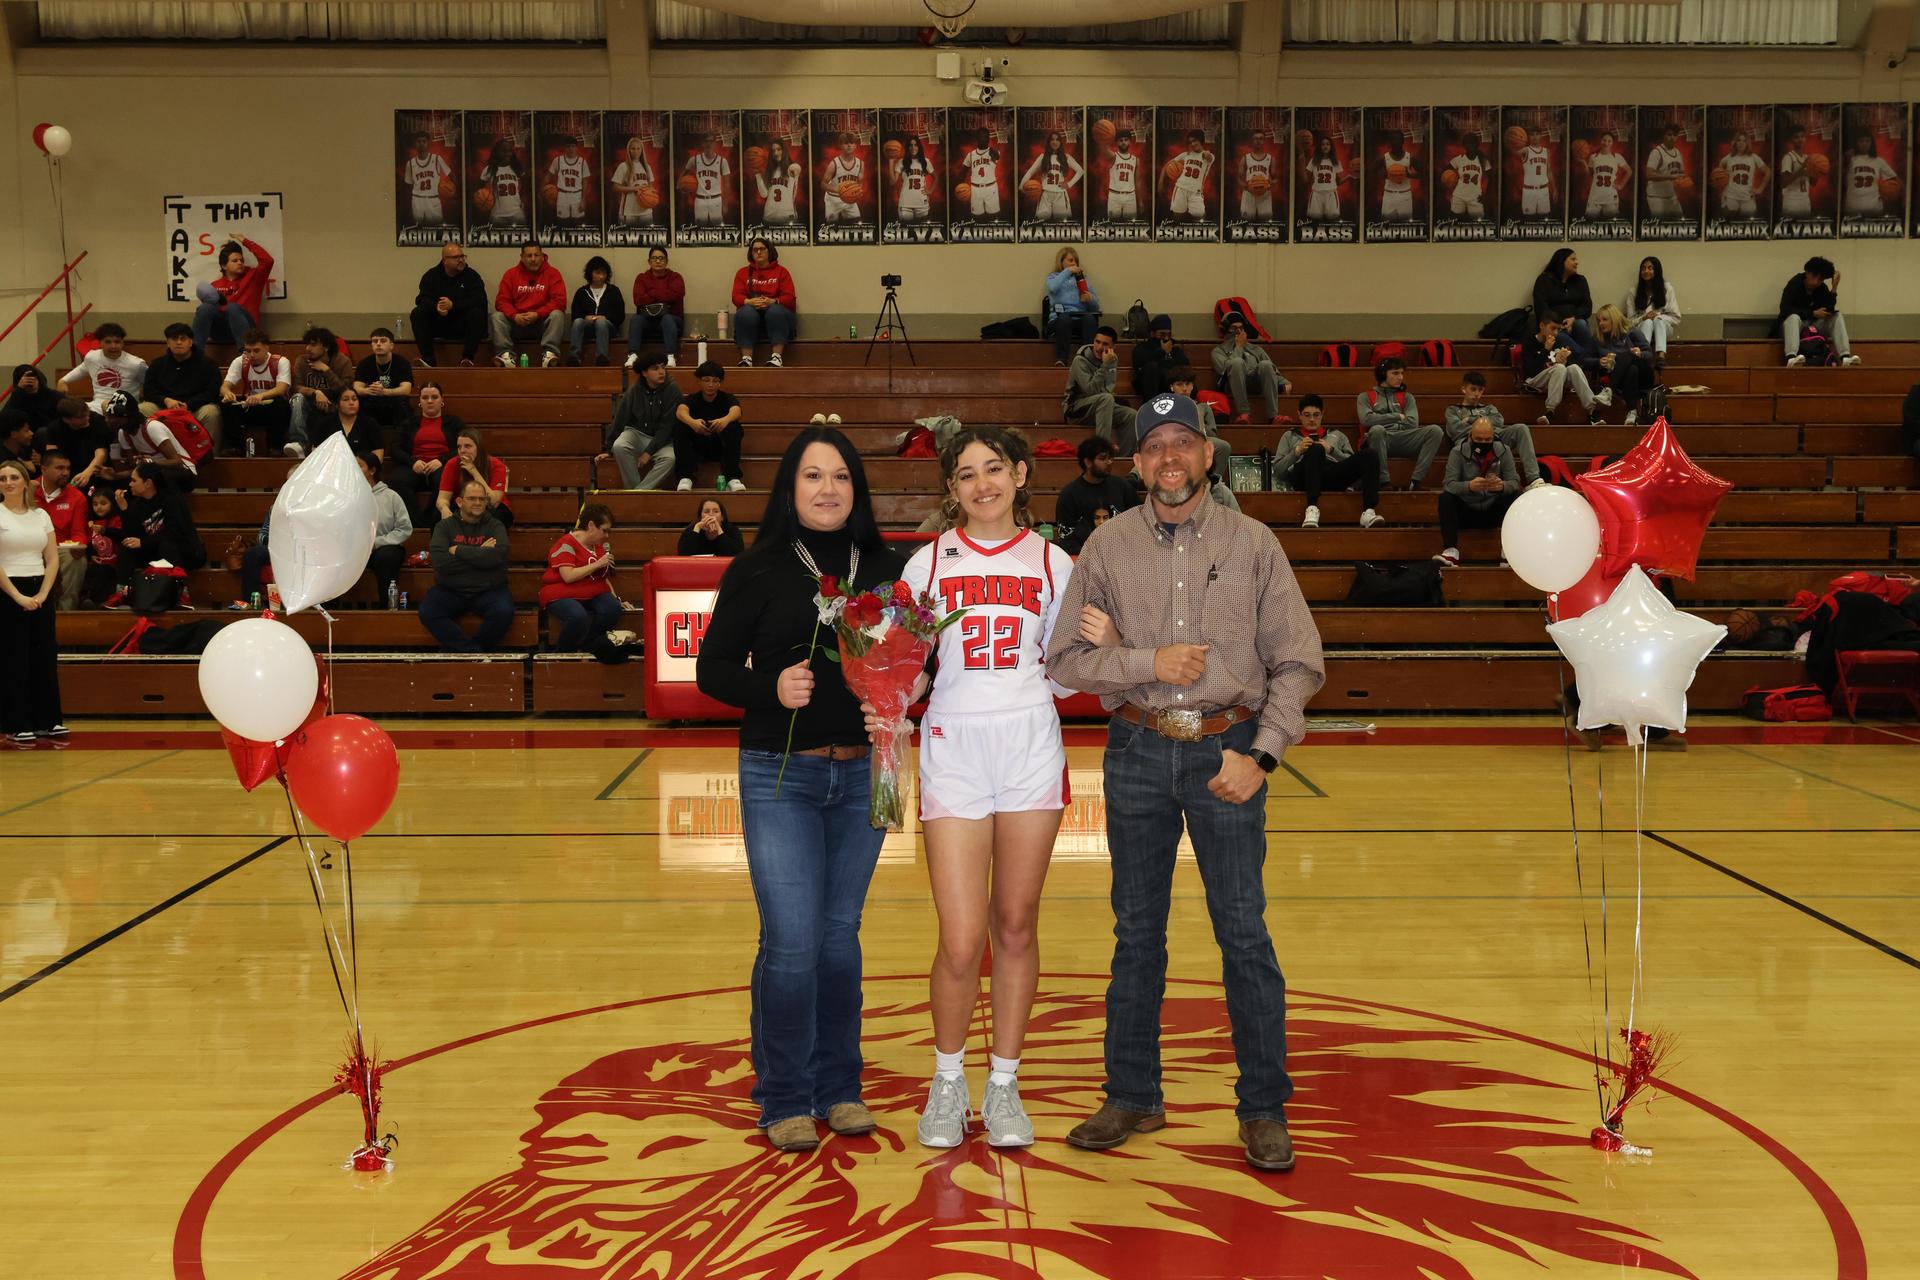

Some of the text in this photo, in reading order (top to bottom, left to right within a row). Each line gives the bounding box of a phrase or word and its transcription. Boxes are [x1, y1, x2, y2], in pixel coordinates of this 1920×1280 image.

[909, 178, 921, 190] 15
[1463, 173, 1479, 185] 24
[498, 183, 517, 197] 20
[205, 202, 269, 223] THAT
[398, 230, 461, 243] AGUILAR
[468, 230, 531, 245] CARTER
[676, 230, 741, 244] BEARDSLEY
[745, 229, 808, 243] PARSONS
[818, 228, 874, 242] SMITH
[883, 227, 945, 242] SILVA
[950, 226, 1015, 241] VAUGHN
[1019, 226, 1083, 241] MARION
[1087, 225, 1151, 241] ESCHEIK
[1156, 225, 1219, 241] ESCHEIK
[1231, 225, 1279, 241] BASS
[1300, 225, 1353, 241] BASS
[1366, 226, 1427, 240] HEMPHILL
[1433, 225, 1496, 240] MOORE
[1500, 225, 1564, 239] DEATHERAGE
[1568, 225, 1633, 239] GONSALVES
[1641, 225, 1697, 239] ROMINE
[1705, 225, 1769, 239] MARCEAUX
[1773, 223, 1833, 238] ALVARA
[537, 231, 602, 245] WALTERS
[607, 231, 667, 245] NEWTON
[168, 204, 192, 301] TAKE
[938, 575, 1043, 616] TRIBE
[961, 615, 1023, 671] 22
